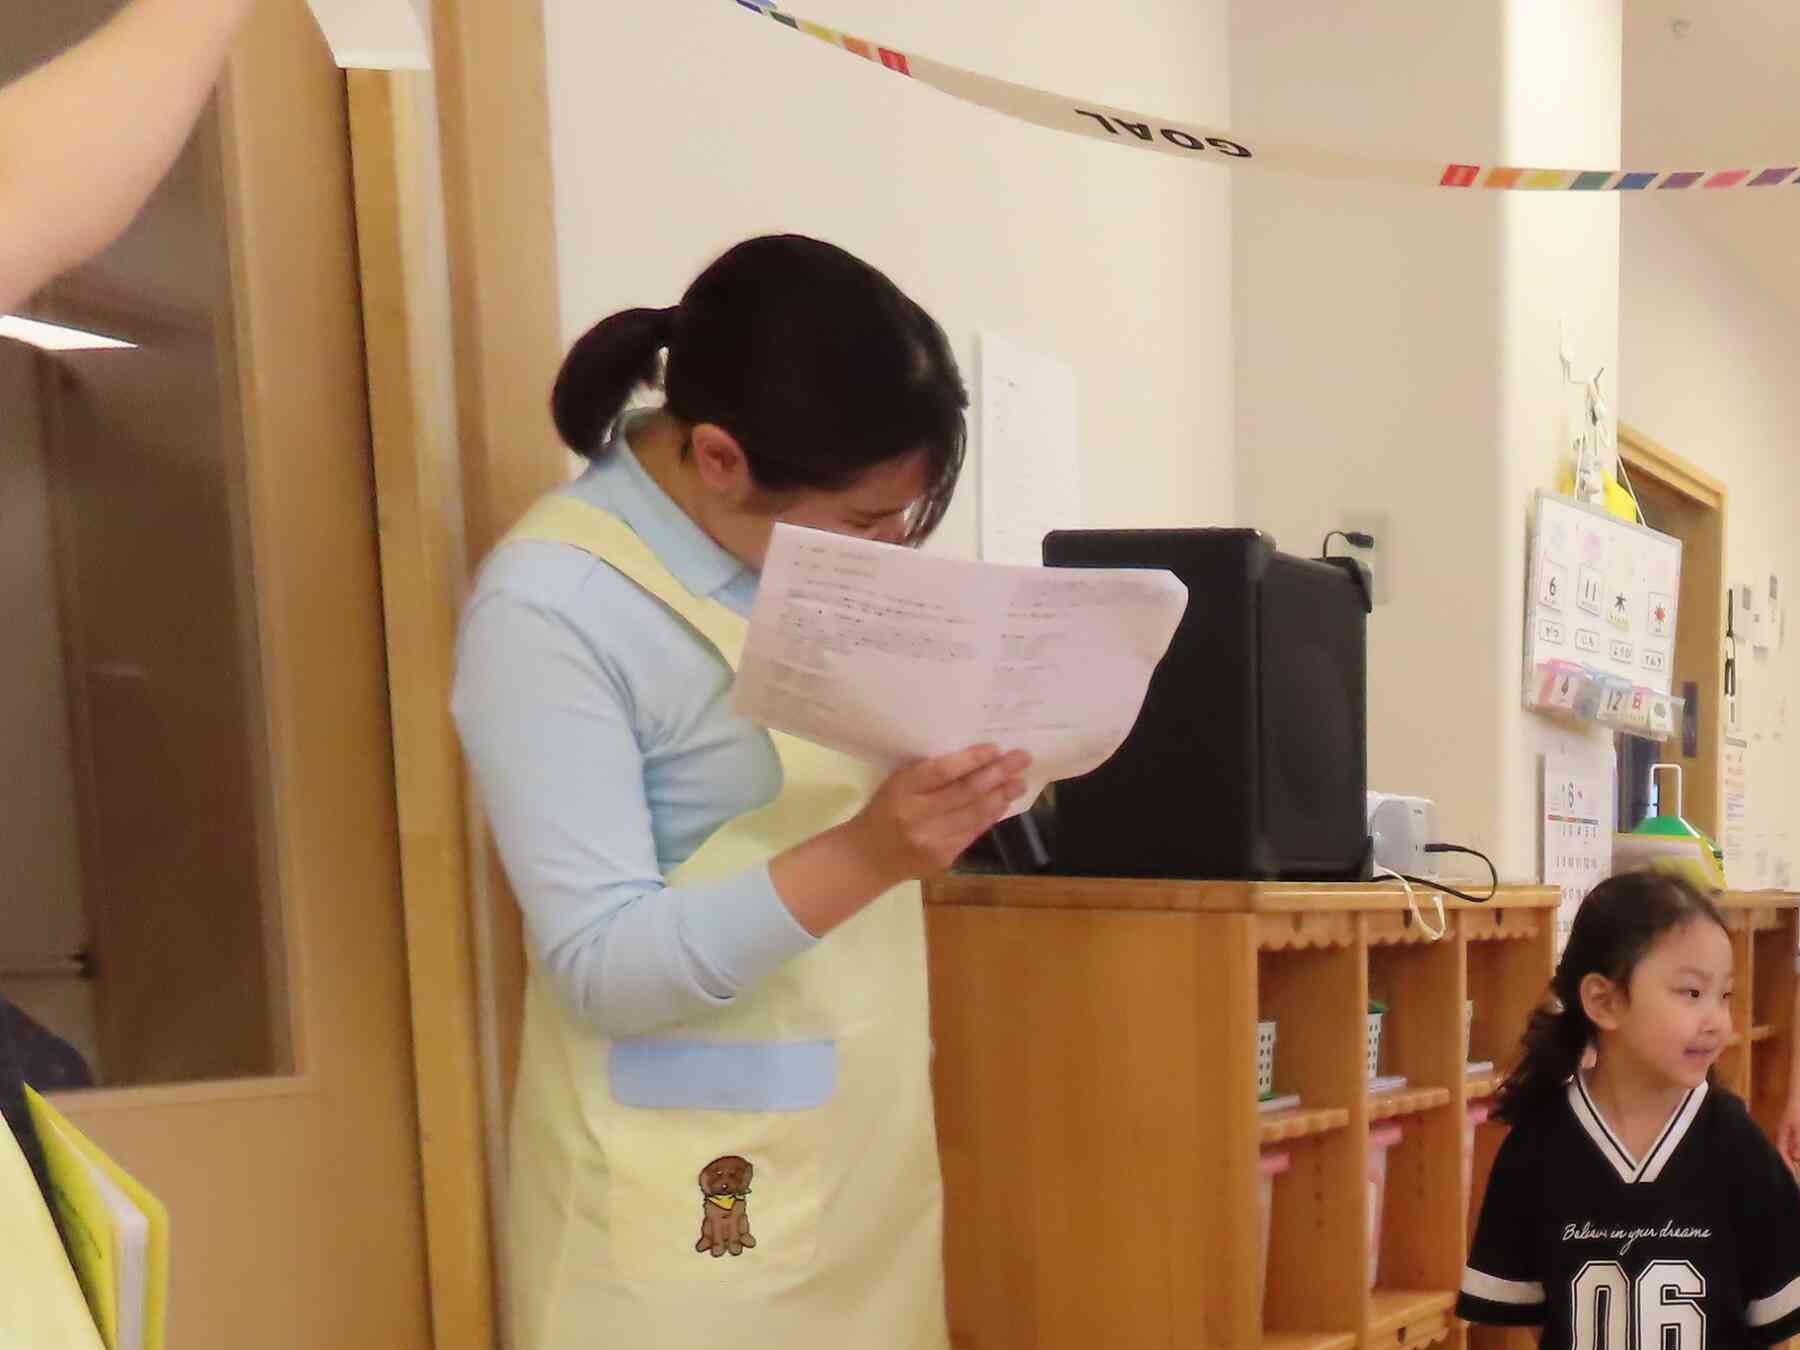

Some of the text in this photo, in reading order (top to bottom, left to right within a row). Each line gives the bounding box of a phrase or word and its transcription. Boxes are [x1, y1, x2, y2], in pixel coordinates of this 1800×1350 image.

[1074, 108, 1253, 158] GOAL
[1548, 575, 1558, 597] 6
[1610, 1227, 1626, 1239] in
